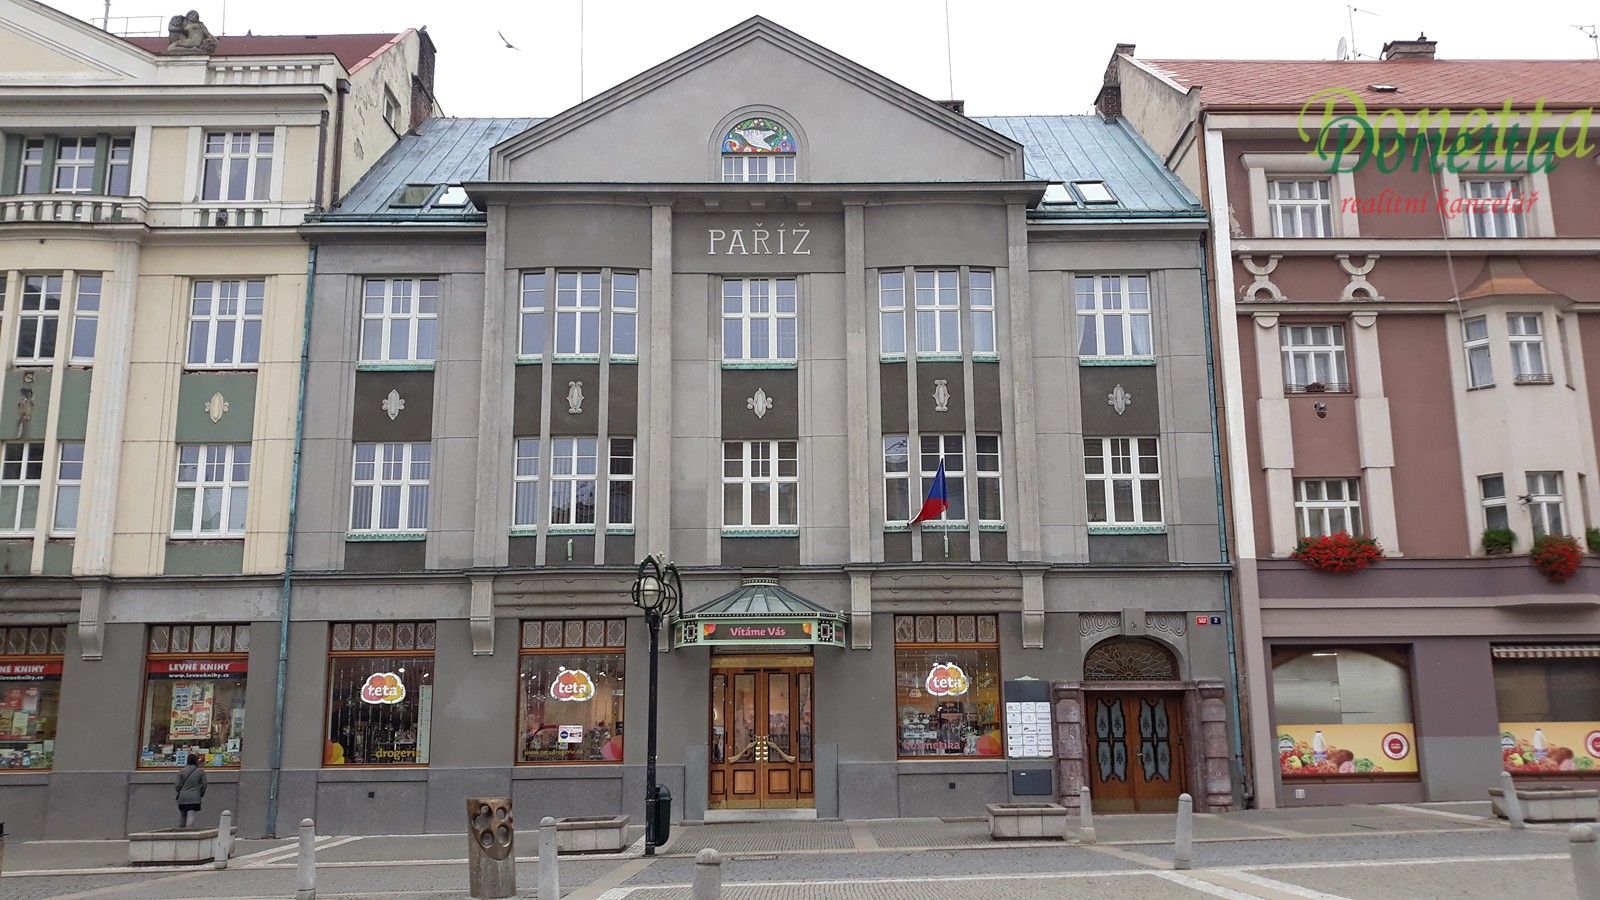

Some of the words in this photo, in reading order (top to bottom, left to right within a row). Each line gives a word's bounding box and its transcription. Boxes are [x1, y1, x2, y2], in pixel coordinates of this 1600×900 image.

[707, 222, 811, 255] PAŘÍŽ
[730, 626, 766, 636] Vítáme
[767, 626, 786, 636] Vás
[14, 664, 45, 673] KNIHY
[168, 663, 197, 671] LEVNÉ
[199, 663, 230, 671] KNIHY
[558, 682, 587, 694] teta
[933, 677, 962, 688] teta
[367, 685, 398, 696] teta
[903, 740, 960, 750] kosmetika
[375, 748, 423, 760] drogerie
